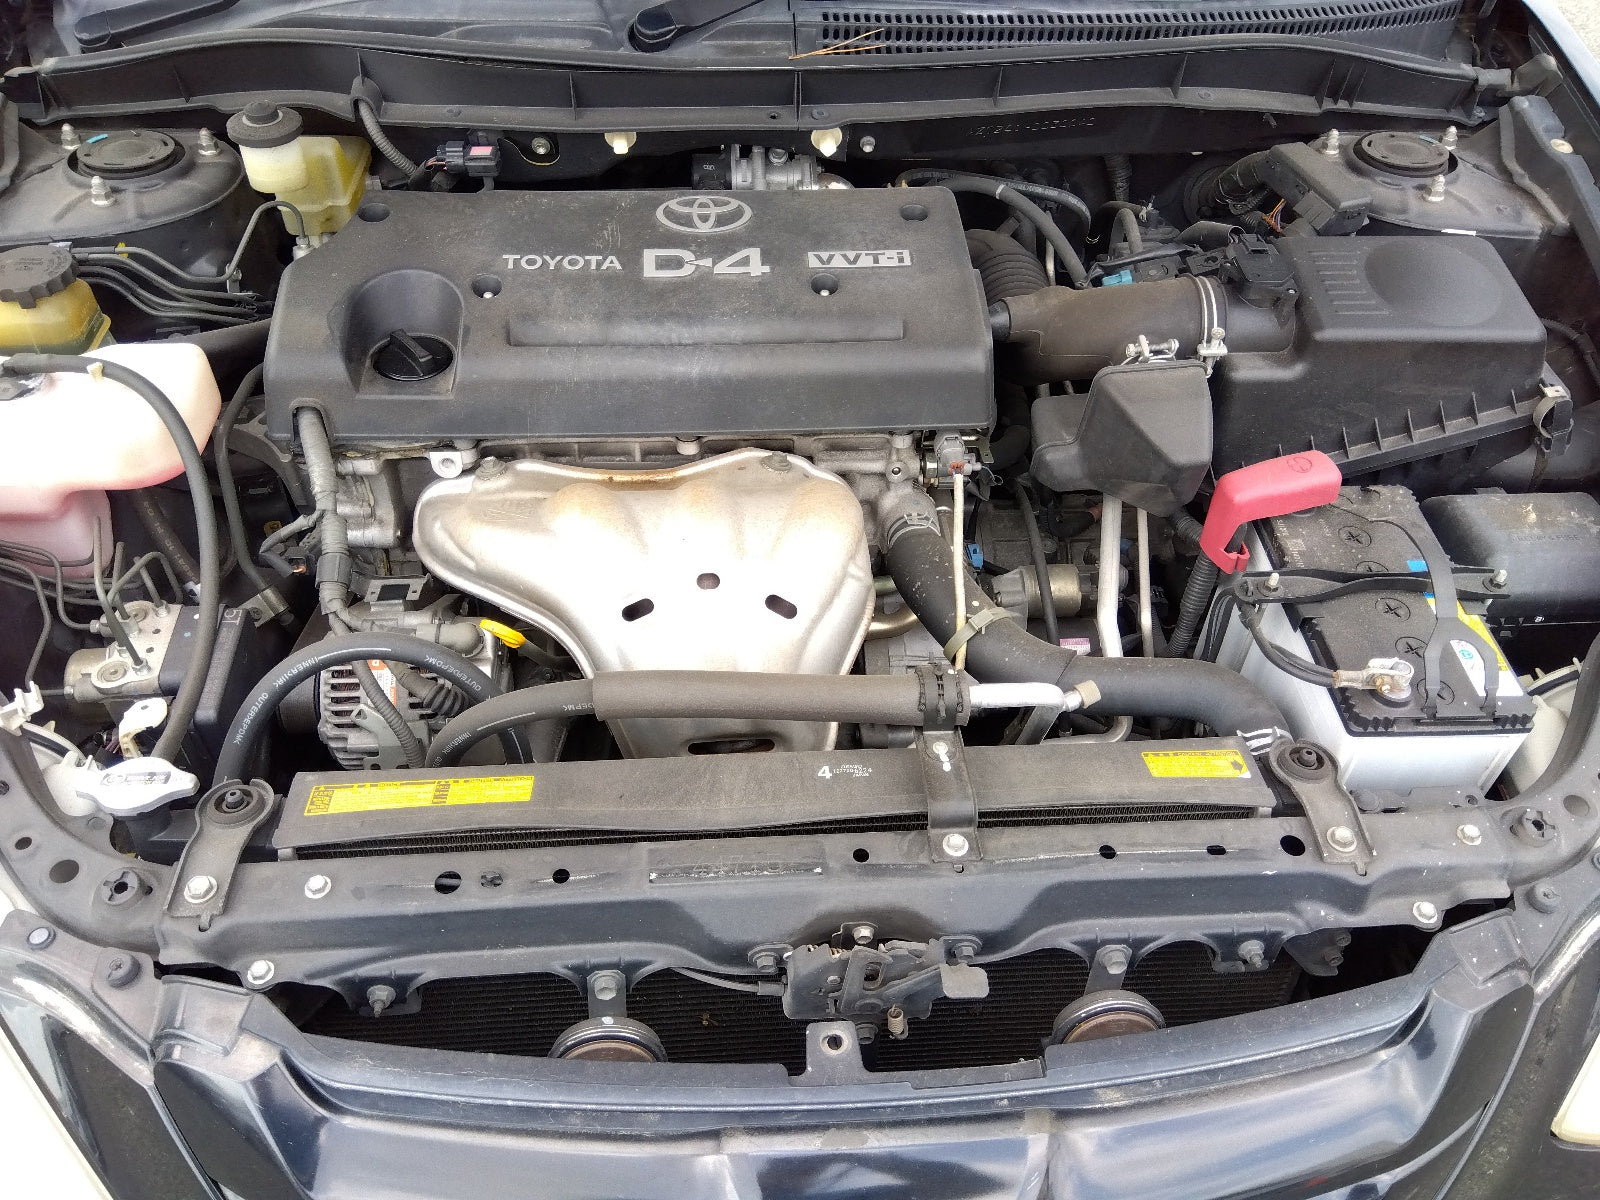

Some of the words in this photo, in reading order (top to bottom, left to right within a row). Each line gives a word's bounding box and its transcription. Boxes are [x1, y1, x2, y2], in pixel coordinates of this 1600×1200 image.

[502, 253, 623, 271] TOYOTA
[642, 247, 771, 278] D-4
[808, 249, 911, 269] VVT-i
[817, 765, 833, 780] 4
